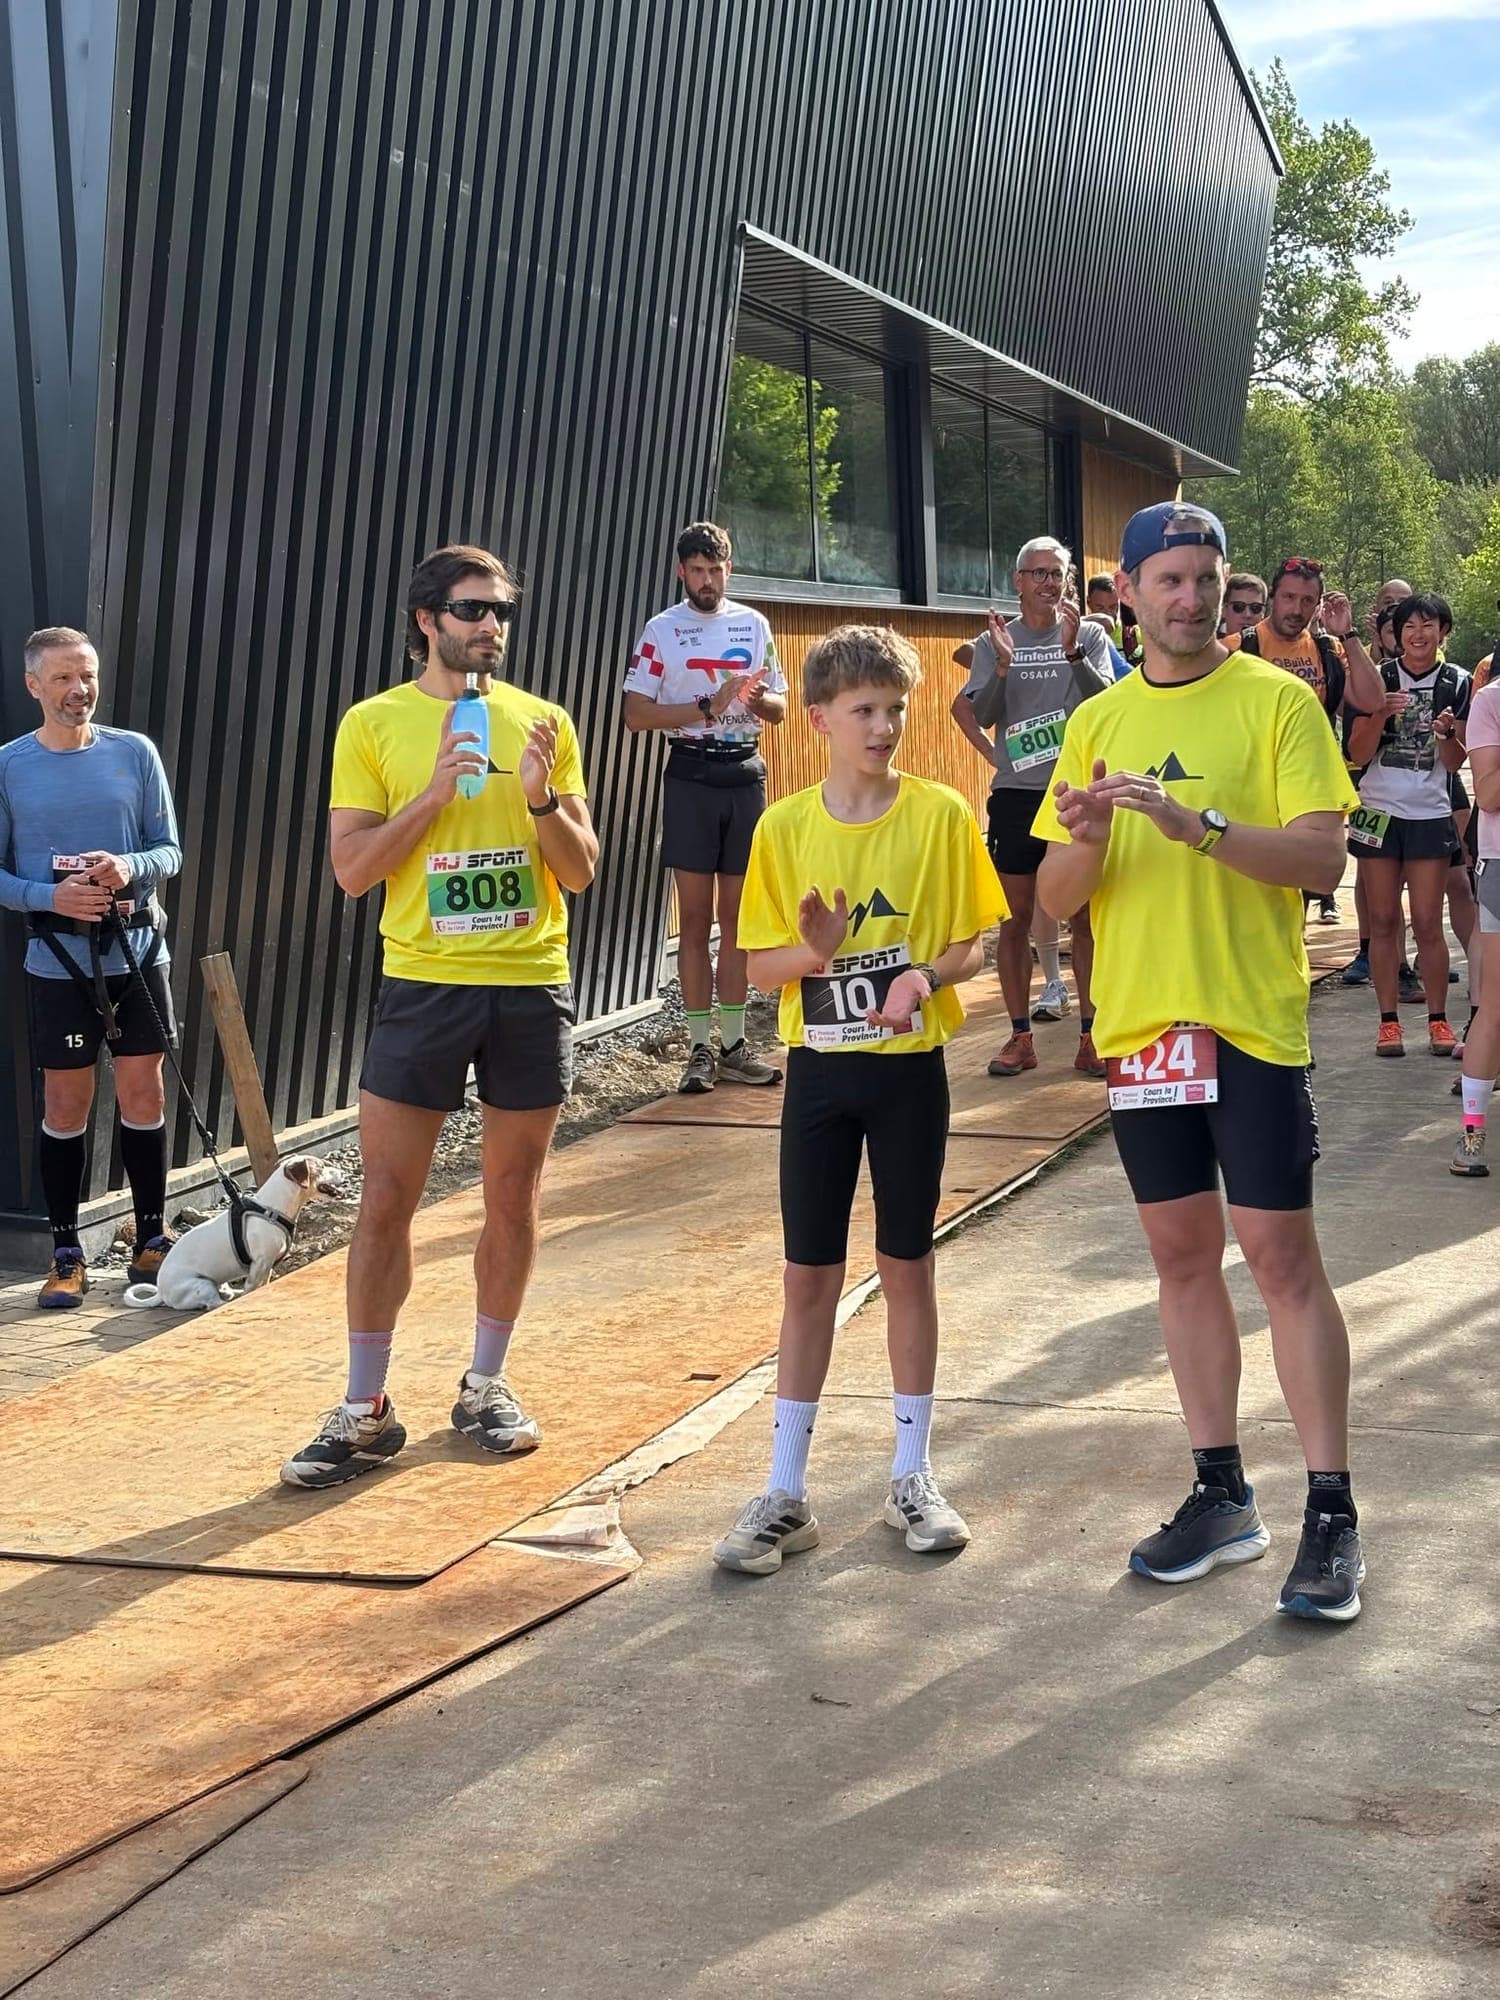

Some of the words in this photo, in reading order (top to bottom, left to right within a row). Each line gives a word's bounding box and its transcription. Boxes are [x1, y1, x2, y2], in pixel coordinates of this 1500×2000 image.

[1283, 656, 1312, 667] Build
[1020, 669, 1058, 680] OSAKA
[1025, 711, 1061, 730] SPORT
[1020, 725, 1058, 753] 801
[58, 858, 80, 868] MJ
[433, 856, 461, 872] MJ
[467, 850, 524, 868] SPORT
[446, 870, 522, 912] 808
[832, 947, 901, 974] SPORT
[829, 977, 877, 1020] 10
[842, 1026, 865, 1034] Cours
[64, 1034, 84, 1048] 15
[1120, 1034, 1196, 1081] 424
[1143, 1087, 1163, 1096] Cours
